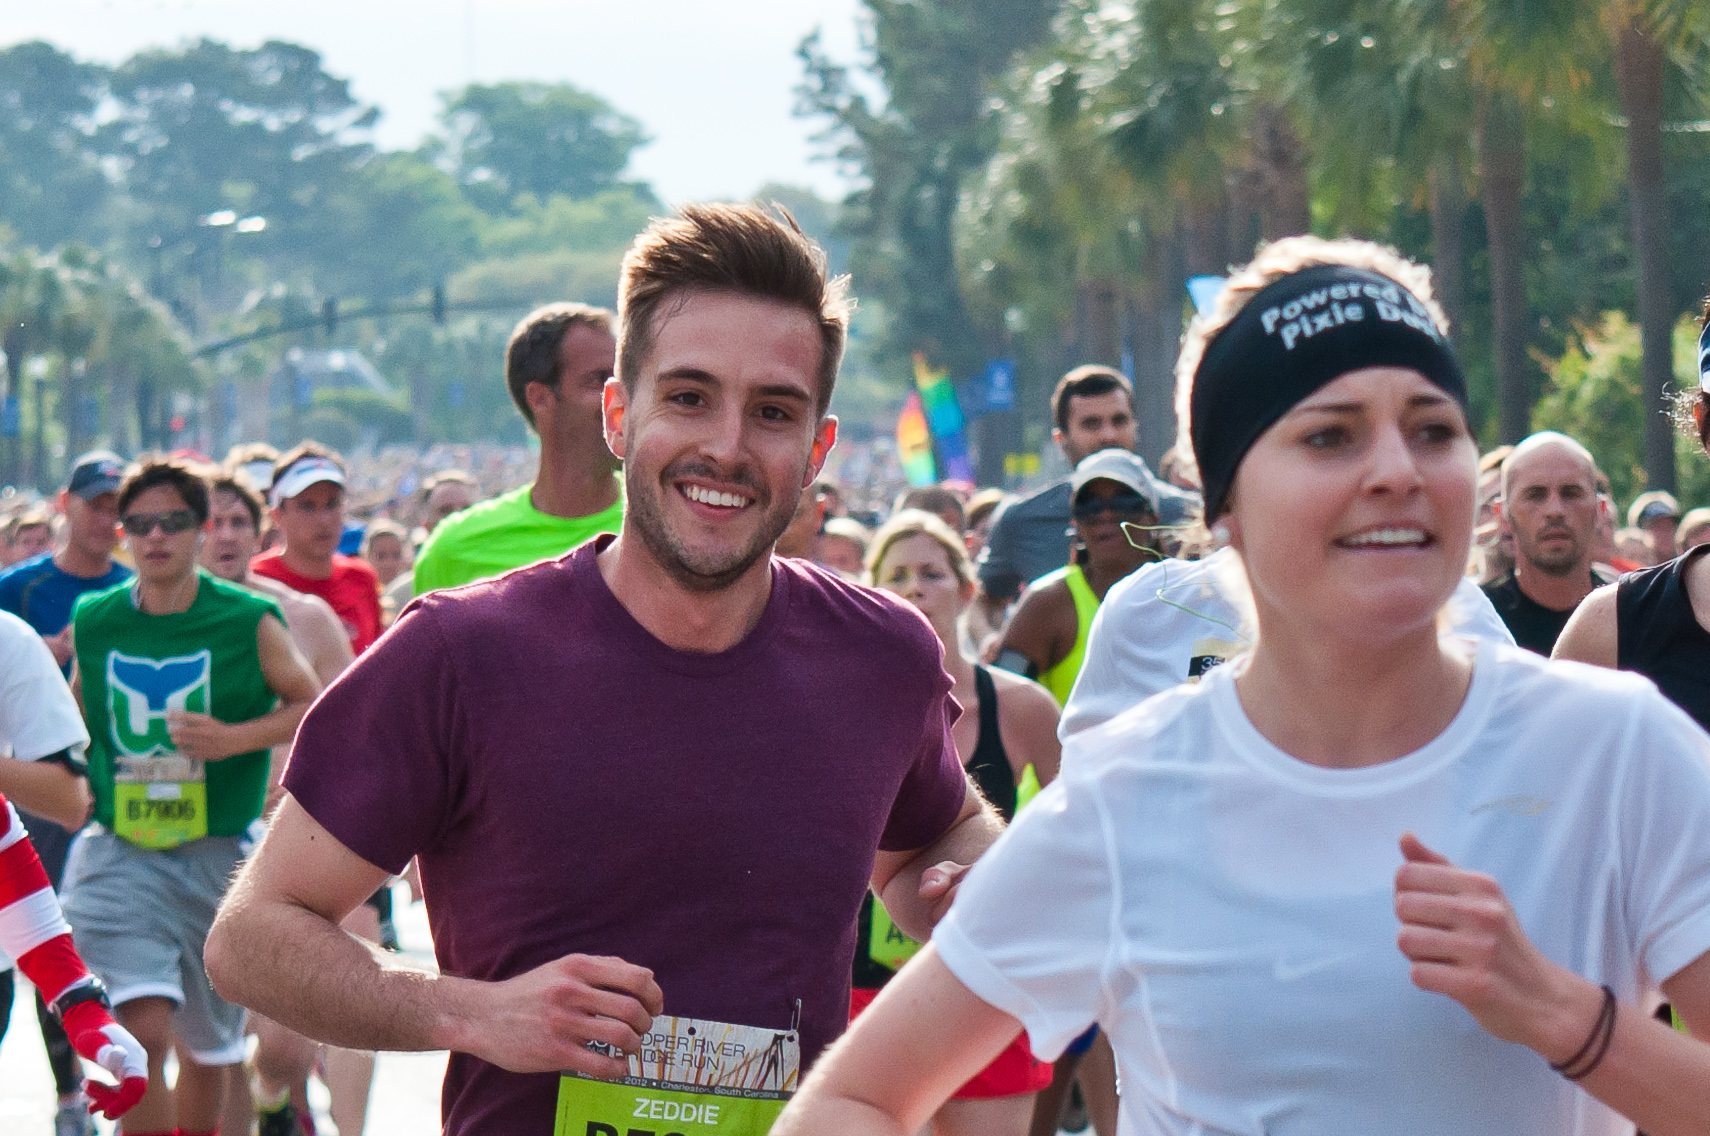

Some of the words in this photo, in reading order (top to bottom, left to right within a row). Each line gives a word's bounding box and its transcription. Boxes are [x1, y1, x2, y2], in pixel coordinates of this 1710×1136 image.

[1261, 282, 1400, 335] Powered
[1280, 302, 1365, 350] Pixie
[641, 1032, 690, 1053] OPER
[694, 1039, 747, 1059] RIVER
[681, 1053, 720, 1071] RUN
[714, 1086, 742, 1097] South
[743, 1088, 779, 1099] Carolina
[632, 1097, 720, 1125] ZEDDIE
